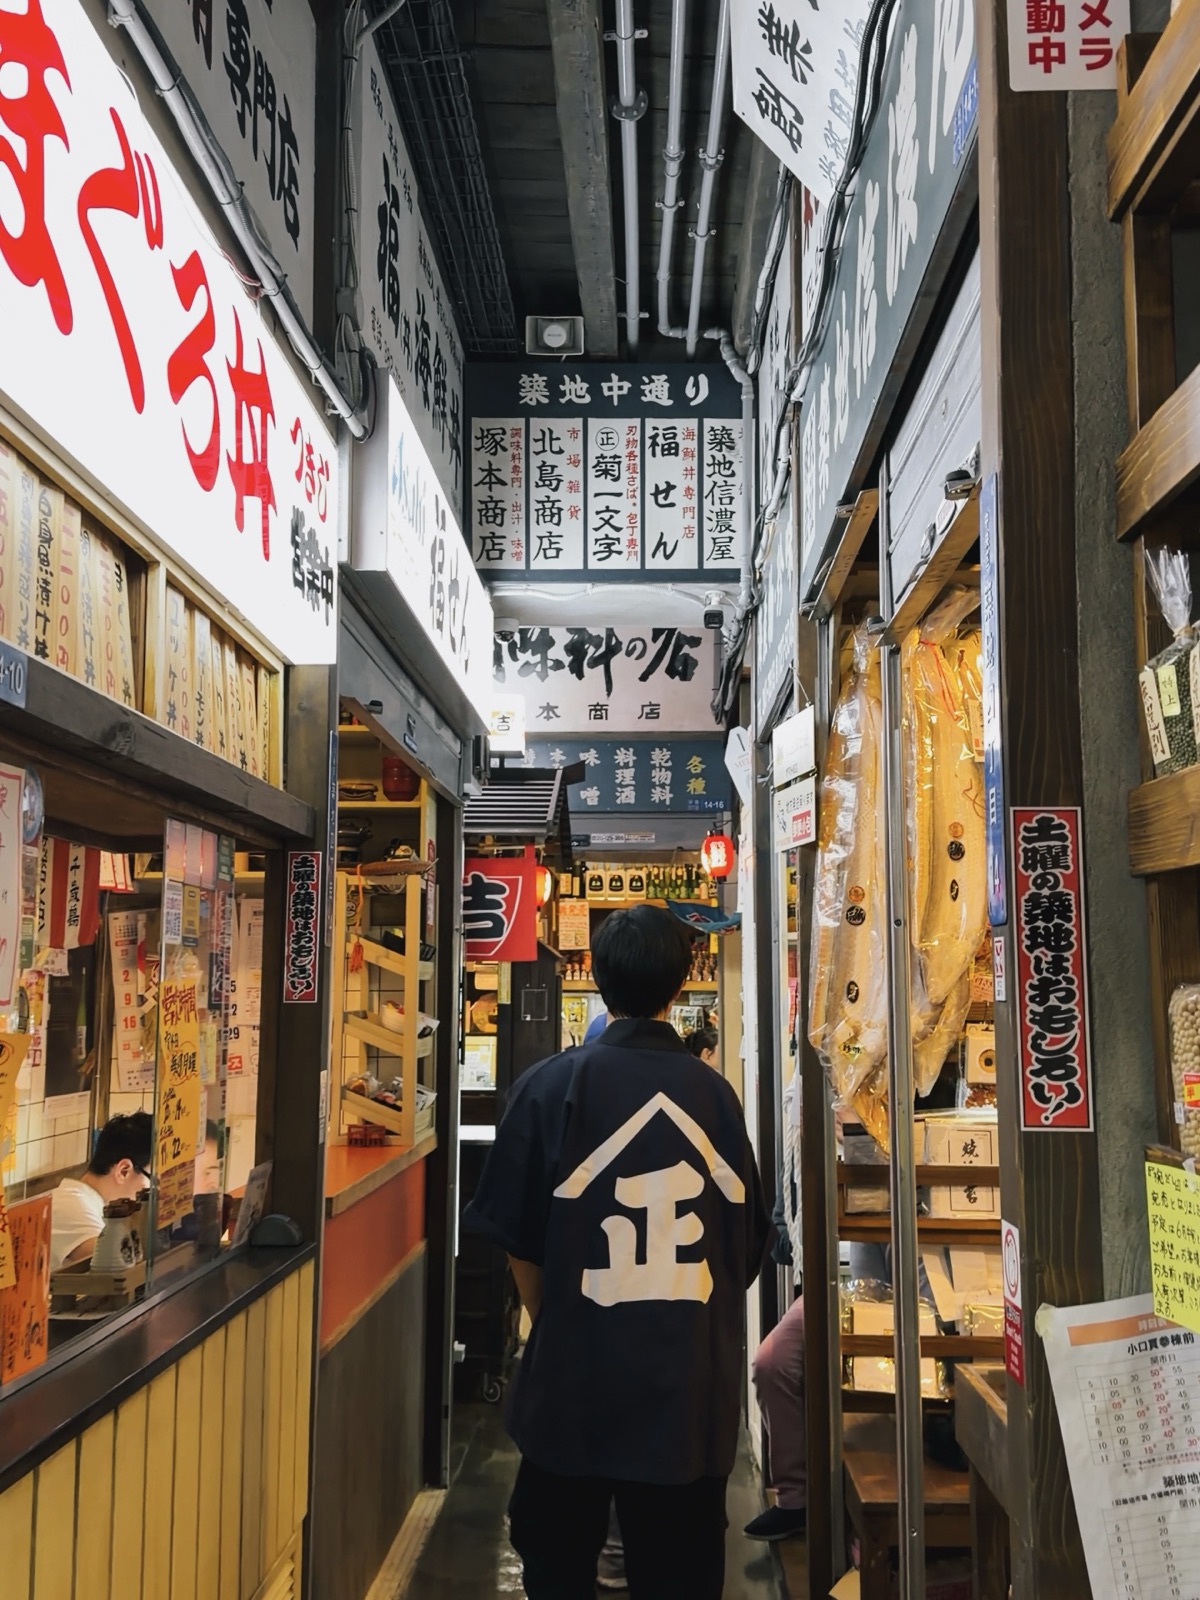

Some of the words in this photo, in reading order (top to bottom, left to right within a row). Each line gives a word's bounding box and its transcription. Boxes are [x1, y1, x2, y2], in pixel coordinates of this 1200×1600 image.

[750, 0, 820, 155] 創業
[1026, 0, 1066, 74] 動中
[222, 0, 301, 252] 専門店
[414, 286, 463, 492] 海鮮丼
[518, 373, 709, 406] 築地中通り
[474, 427, 508, 563] 塚本商店
[533, 427, 565, 562] 北島商店
[566, 427, 581, 521] 市場雑貨
[648, 425, 679, 561] 福せん
[681, 427, 696, 539] 海鮮丼専門店
[705, 425, 737, 561] 築地信濃屋
[494, 627, 702, 698] 味料の店
[497, 714, 511, 732] 吉
[579, 749, 601, 806] 味噌
[614, 747, 637, 805] 料理酒
[685, 755, 706, 795] 各種
[1163, 1473, 1200, 1488] 築地地
